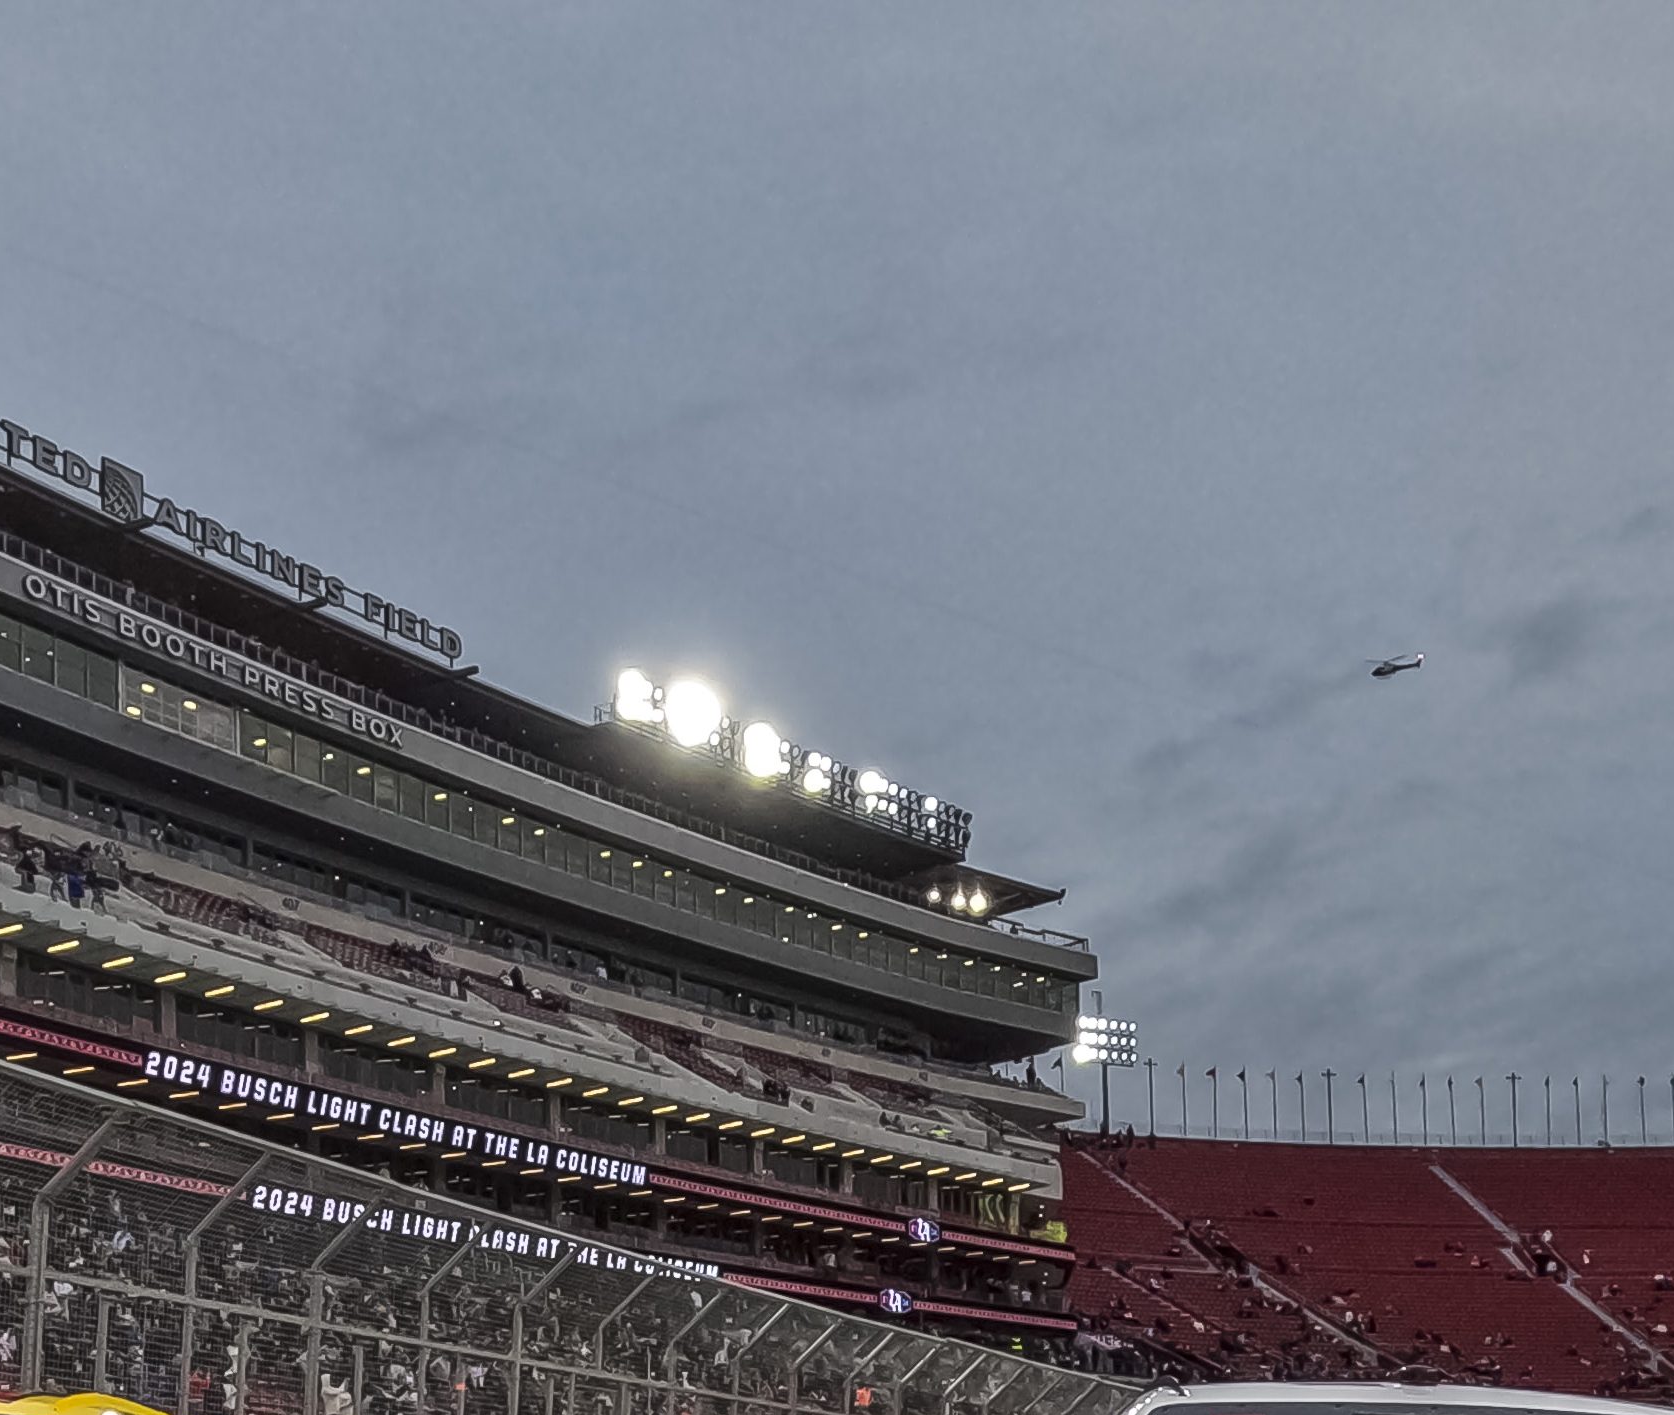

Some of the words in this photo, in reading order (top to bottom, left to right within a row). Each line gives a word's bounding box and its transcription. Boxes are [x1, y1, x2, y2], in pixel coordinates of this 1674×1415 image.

[156, 498, 345, 606] AIRLINES
[363, 592, 463, 660] FIELD
[24, 575, 102, 624] OTIS
[119, 616, 228, 676] BOOTH
[243, 668, 335, 720] PRESS
[351, 710, 404, 748] BOX
[145, 1051, 212, 1088] 2024
[220, 1069, 299, 1109] BUSCH
[307, 1091, 371, 1125] LIGHT
[379, 1108, 444, 1143] CLASH
[452, 1126, 477, 1149] AT
[485, 1132, 519, 1159] THE
[527, 1142, 548, 1165] LA
[557, 1150, 647, 1185] COLISEUM
[252, 1186, 313, 1217] 2024
[402, 1212, 462, 1244] LIGHT
[537, 1238, 561, 1258] AT
